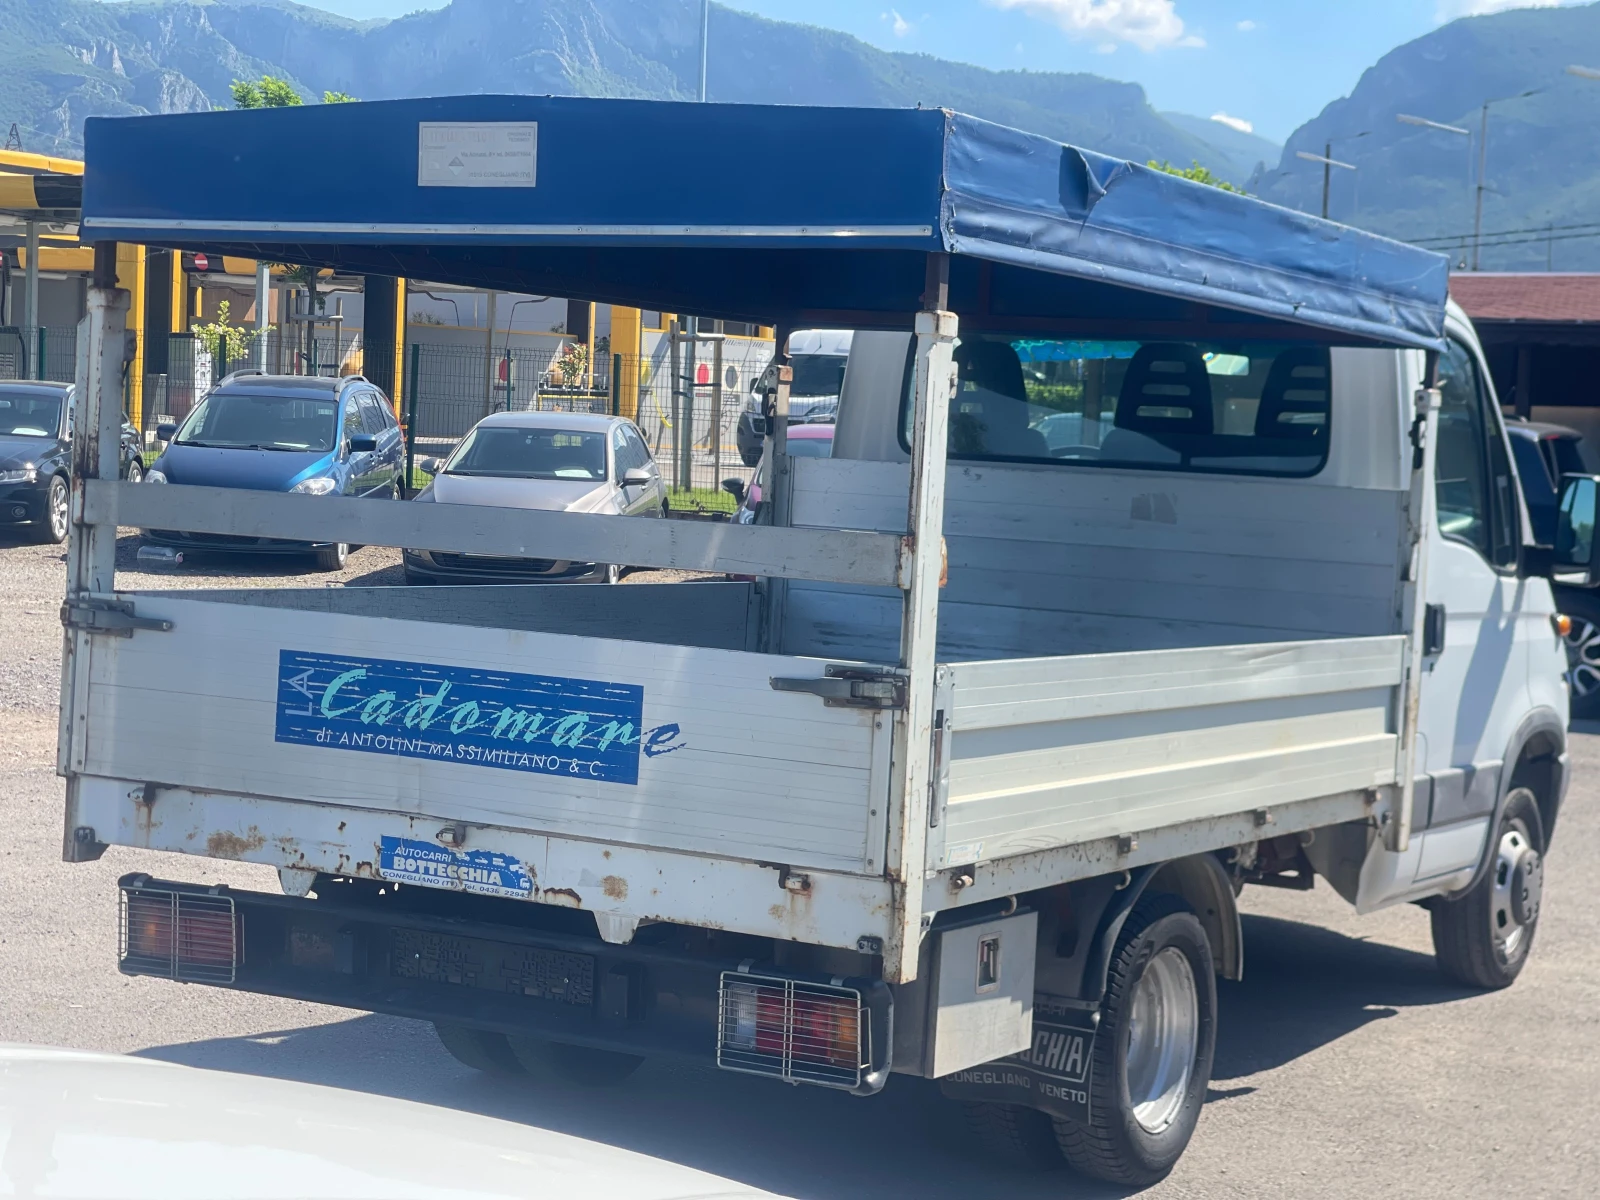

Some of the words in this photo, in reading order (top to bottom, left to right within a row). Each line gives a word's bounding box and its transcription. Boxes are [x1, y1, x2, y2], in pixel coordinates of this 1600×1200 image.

[285, 667, 315, 717] LA
[320, 668, 687, 758] Cadomare
[316, 728, 331, 743] di
[339, 732, 422, 754] ANTOLINI
[428, 743, 560, 771] MASSIMILIANO
[568, 759, 581, 774] &
[589, 761, 606, 777] C.
[394, 846, 452, 863] AUTOCARRI
[382, 871, 440, 885] CONEGLIANO
[393, 856, 503, 886] BOTTECCHIA
[1038, 1082, 1087, 1104] VENETO
